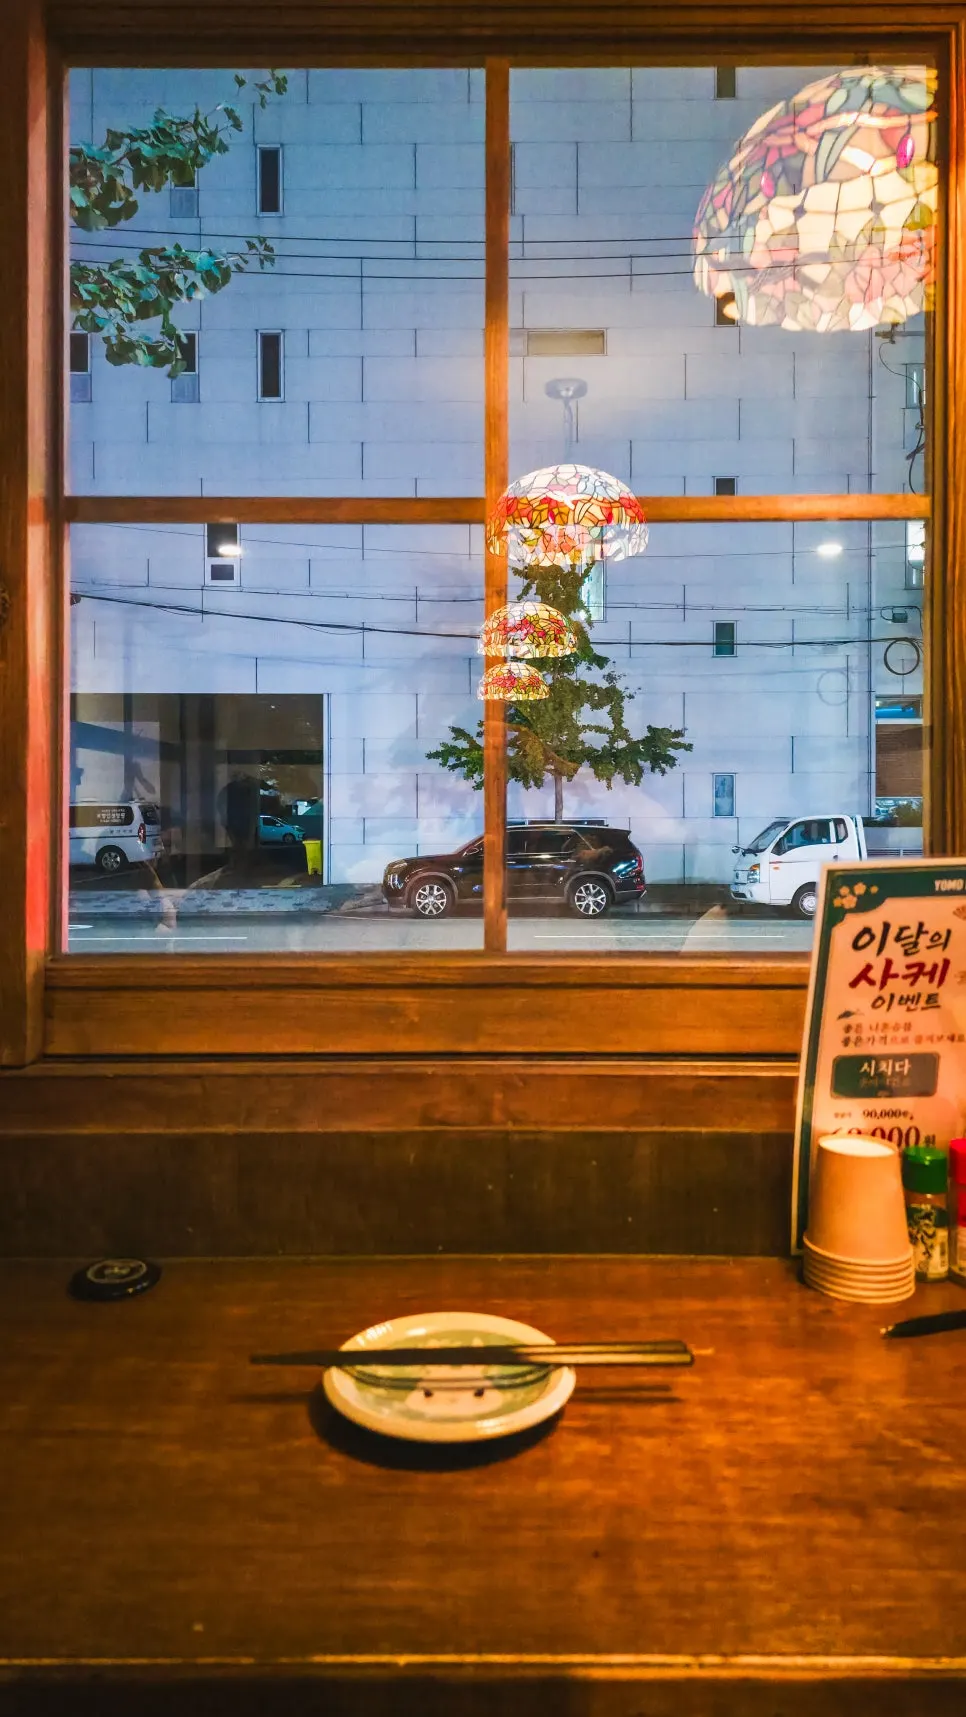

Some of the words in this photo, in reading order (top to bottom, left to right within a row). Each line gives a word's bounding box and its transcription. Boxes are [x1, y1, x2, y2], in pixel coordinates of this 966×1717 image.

[852, 921, 951, 957] 이달의
[848, 957, 951, 991] 사케
[871, 992, 941, 1012] 이벤트
